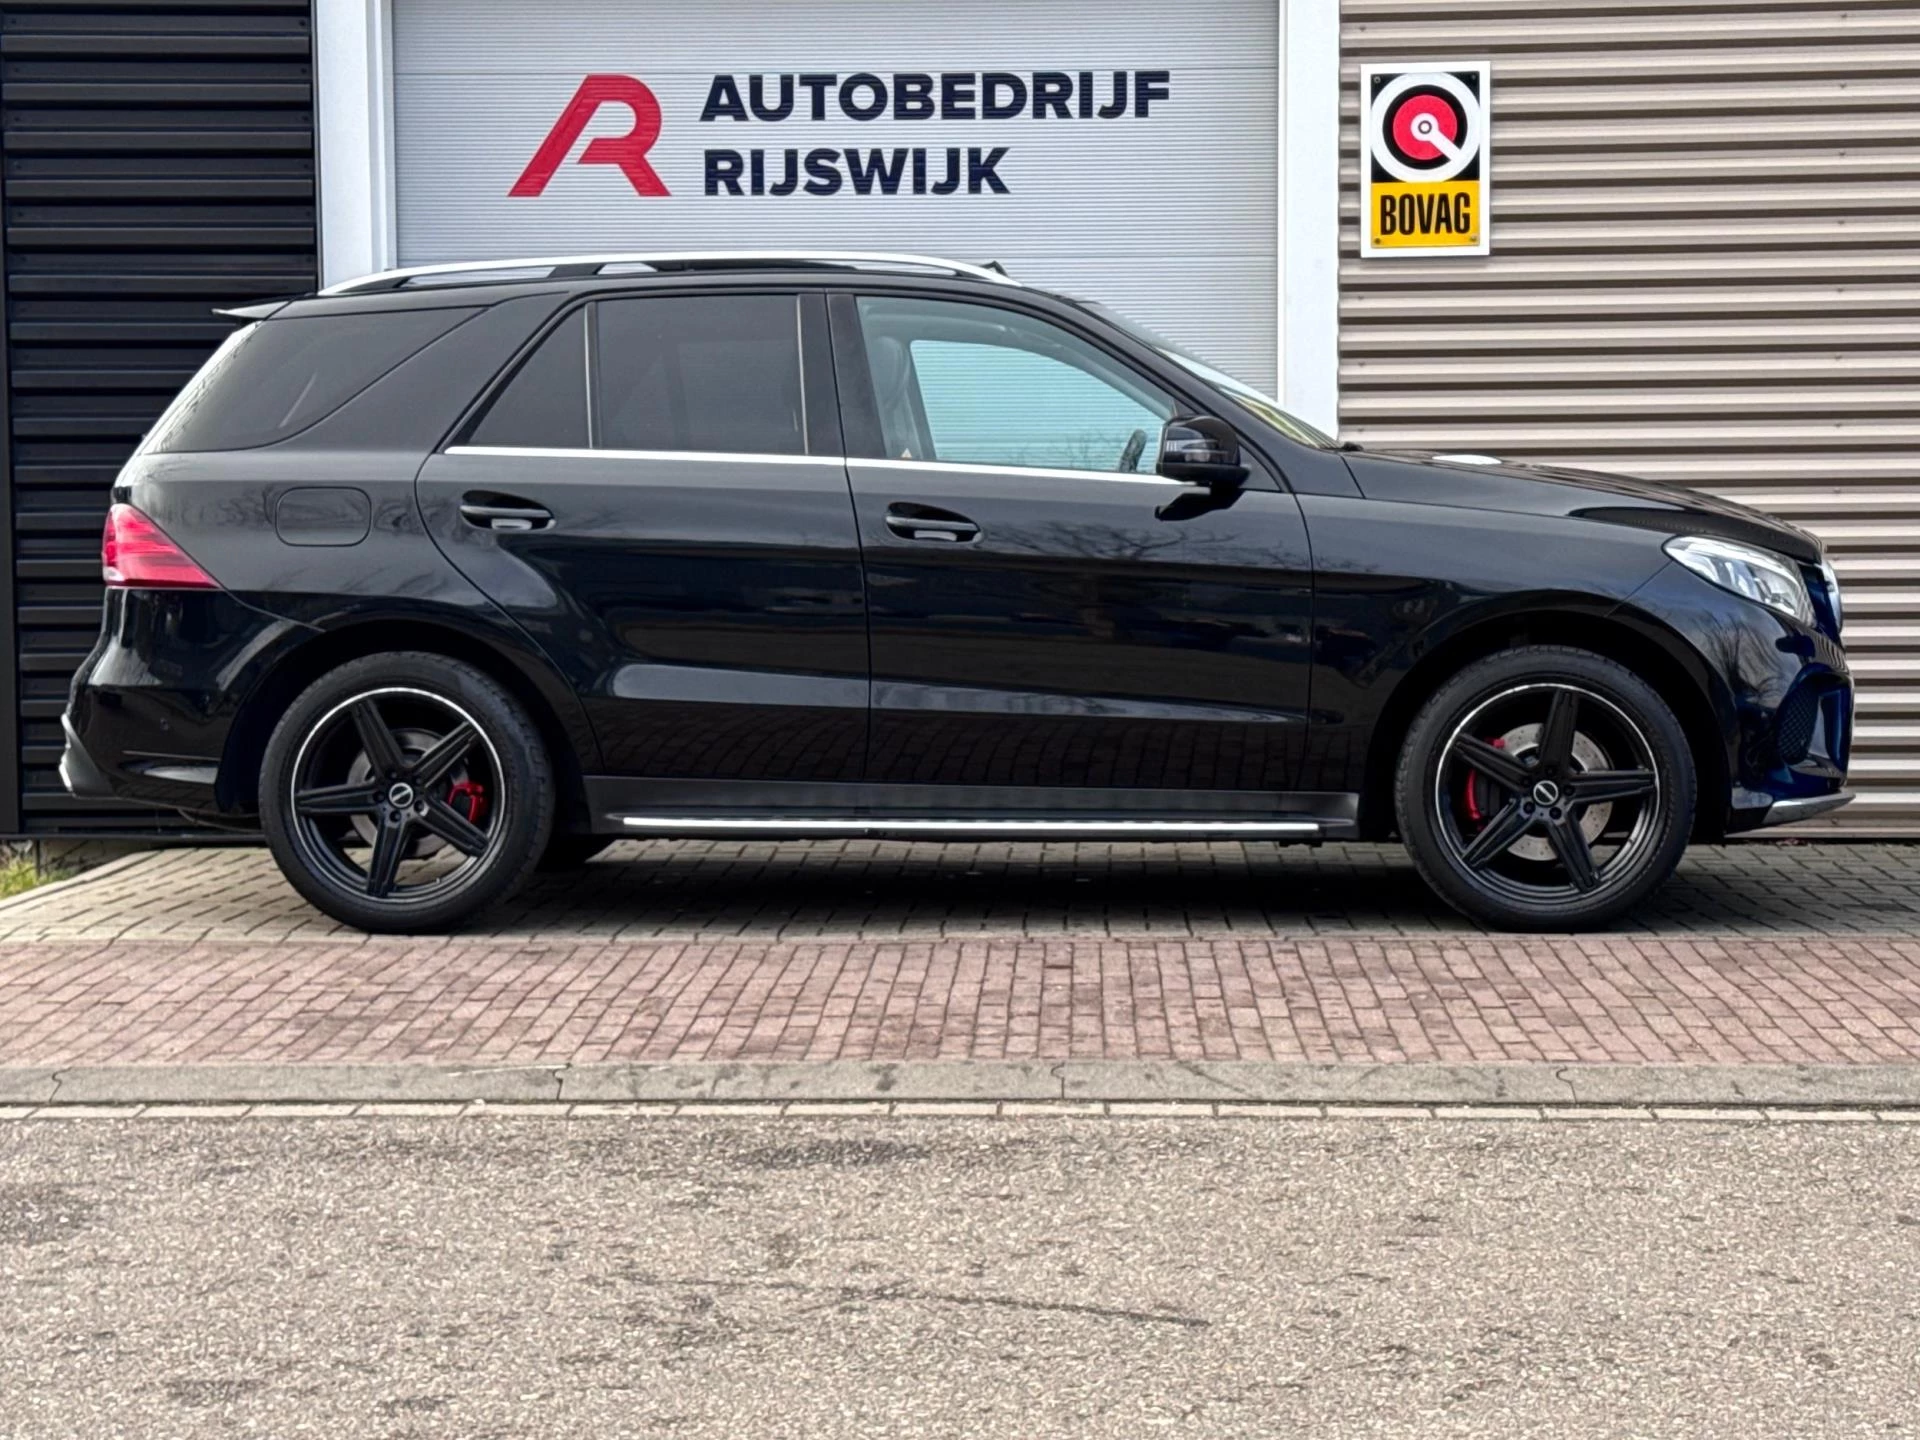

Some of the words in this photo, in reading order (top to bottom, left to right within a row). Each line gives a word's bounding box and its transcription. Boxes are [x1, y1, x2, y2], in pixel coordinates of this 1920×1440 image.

[700, 70, 1170, 121] AUTOBEDRIJF
[704, 147, 1010, 197] RIJSWIJK
[1380, 192, 1471, 235] BOVAG
